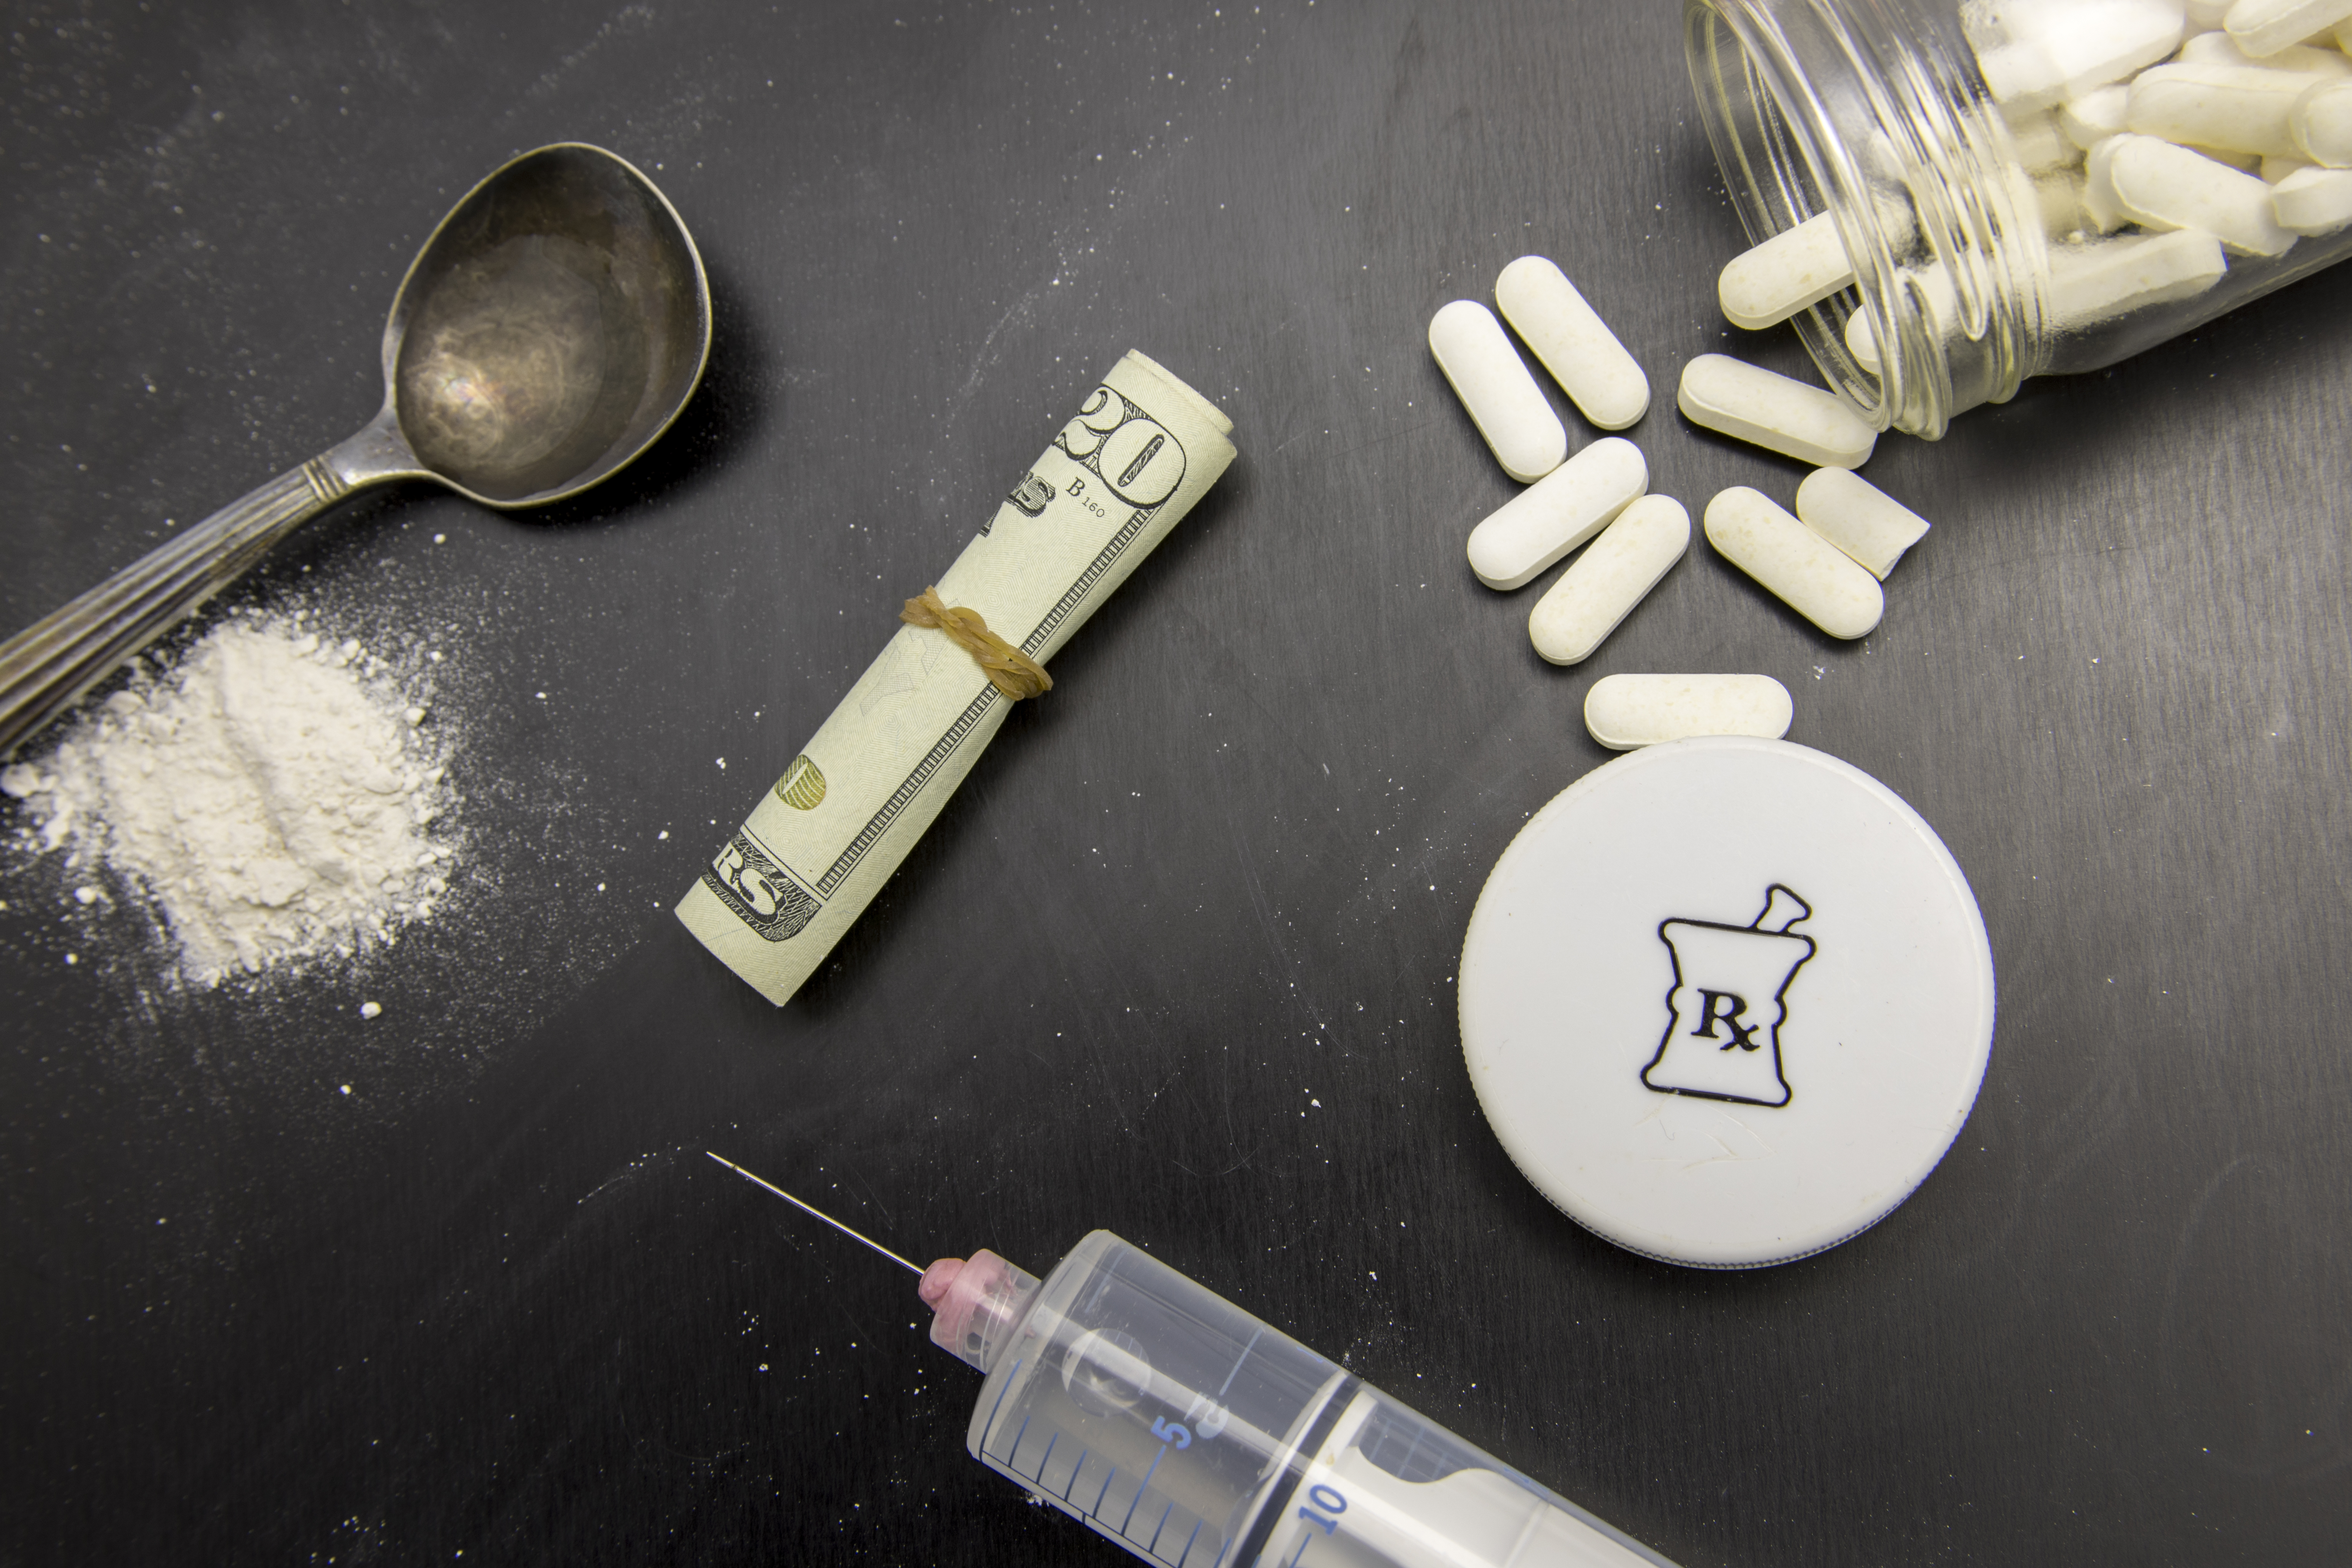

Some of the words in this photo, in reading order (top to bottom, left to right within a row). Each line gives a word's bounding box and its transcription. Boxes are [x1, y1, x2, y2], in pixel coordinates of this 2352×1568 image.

[1052, 382, 1187, 510] 20
[1690, 988, 1760, 1052] Rx
[1151, 1415, 1192, 1450] 5
[1298, 1484, 1347, 1536] 10
